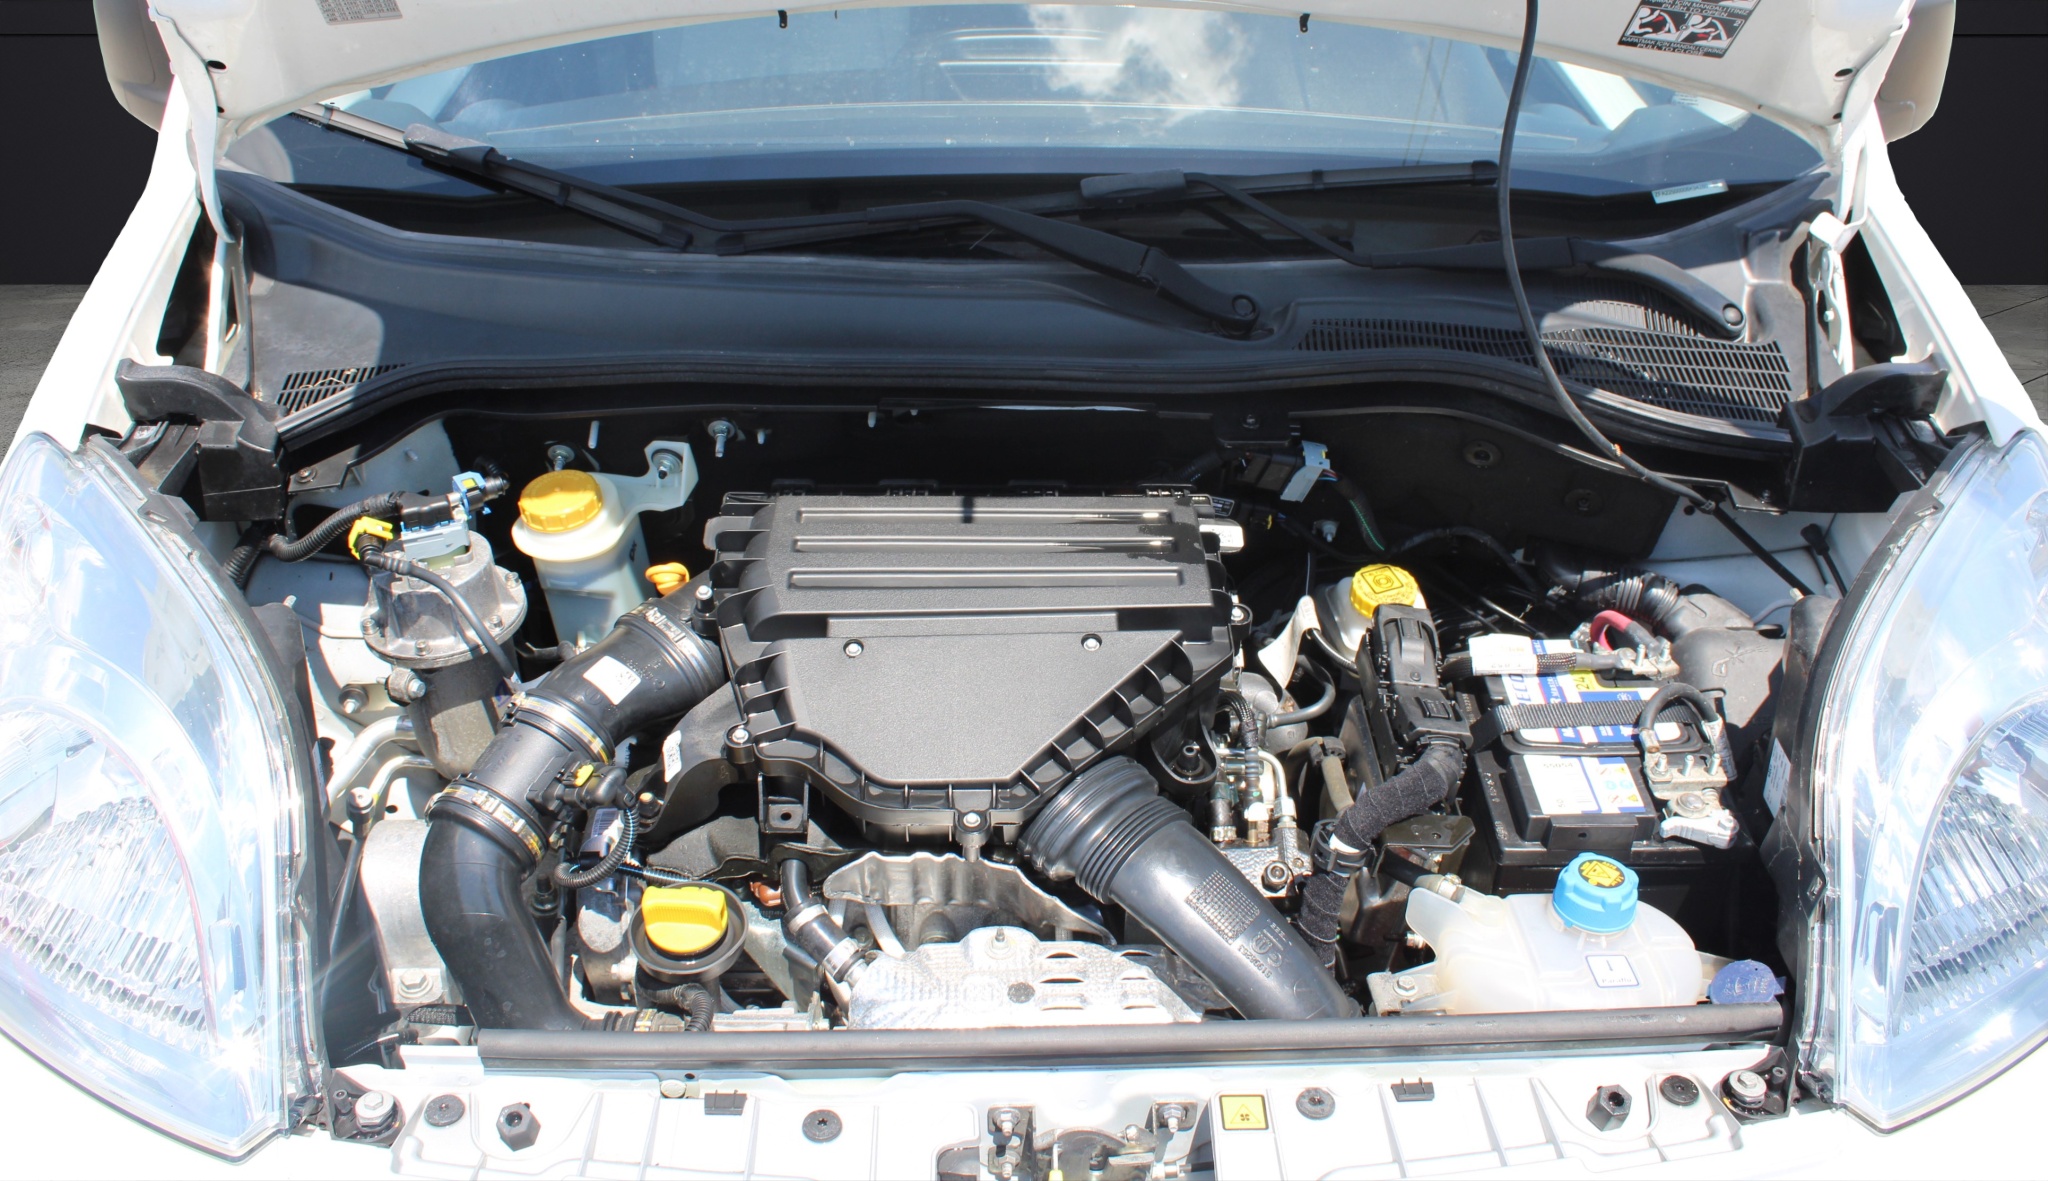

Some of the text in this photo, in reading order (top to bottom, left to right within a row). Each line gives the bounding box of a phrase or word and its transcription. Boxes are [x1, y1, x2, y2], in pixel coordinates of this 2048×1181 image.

[1662, 3, 1687, 12] PUSH
[1702, 9, 1728, 17] OPEN
[1674, 48, 1704, 57] CLOSE
[1573, 676, 1590, 690] 24
